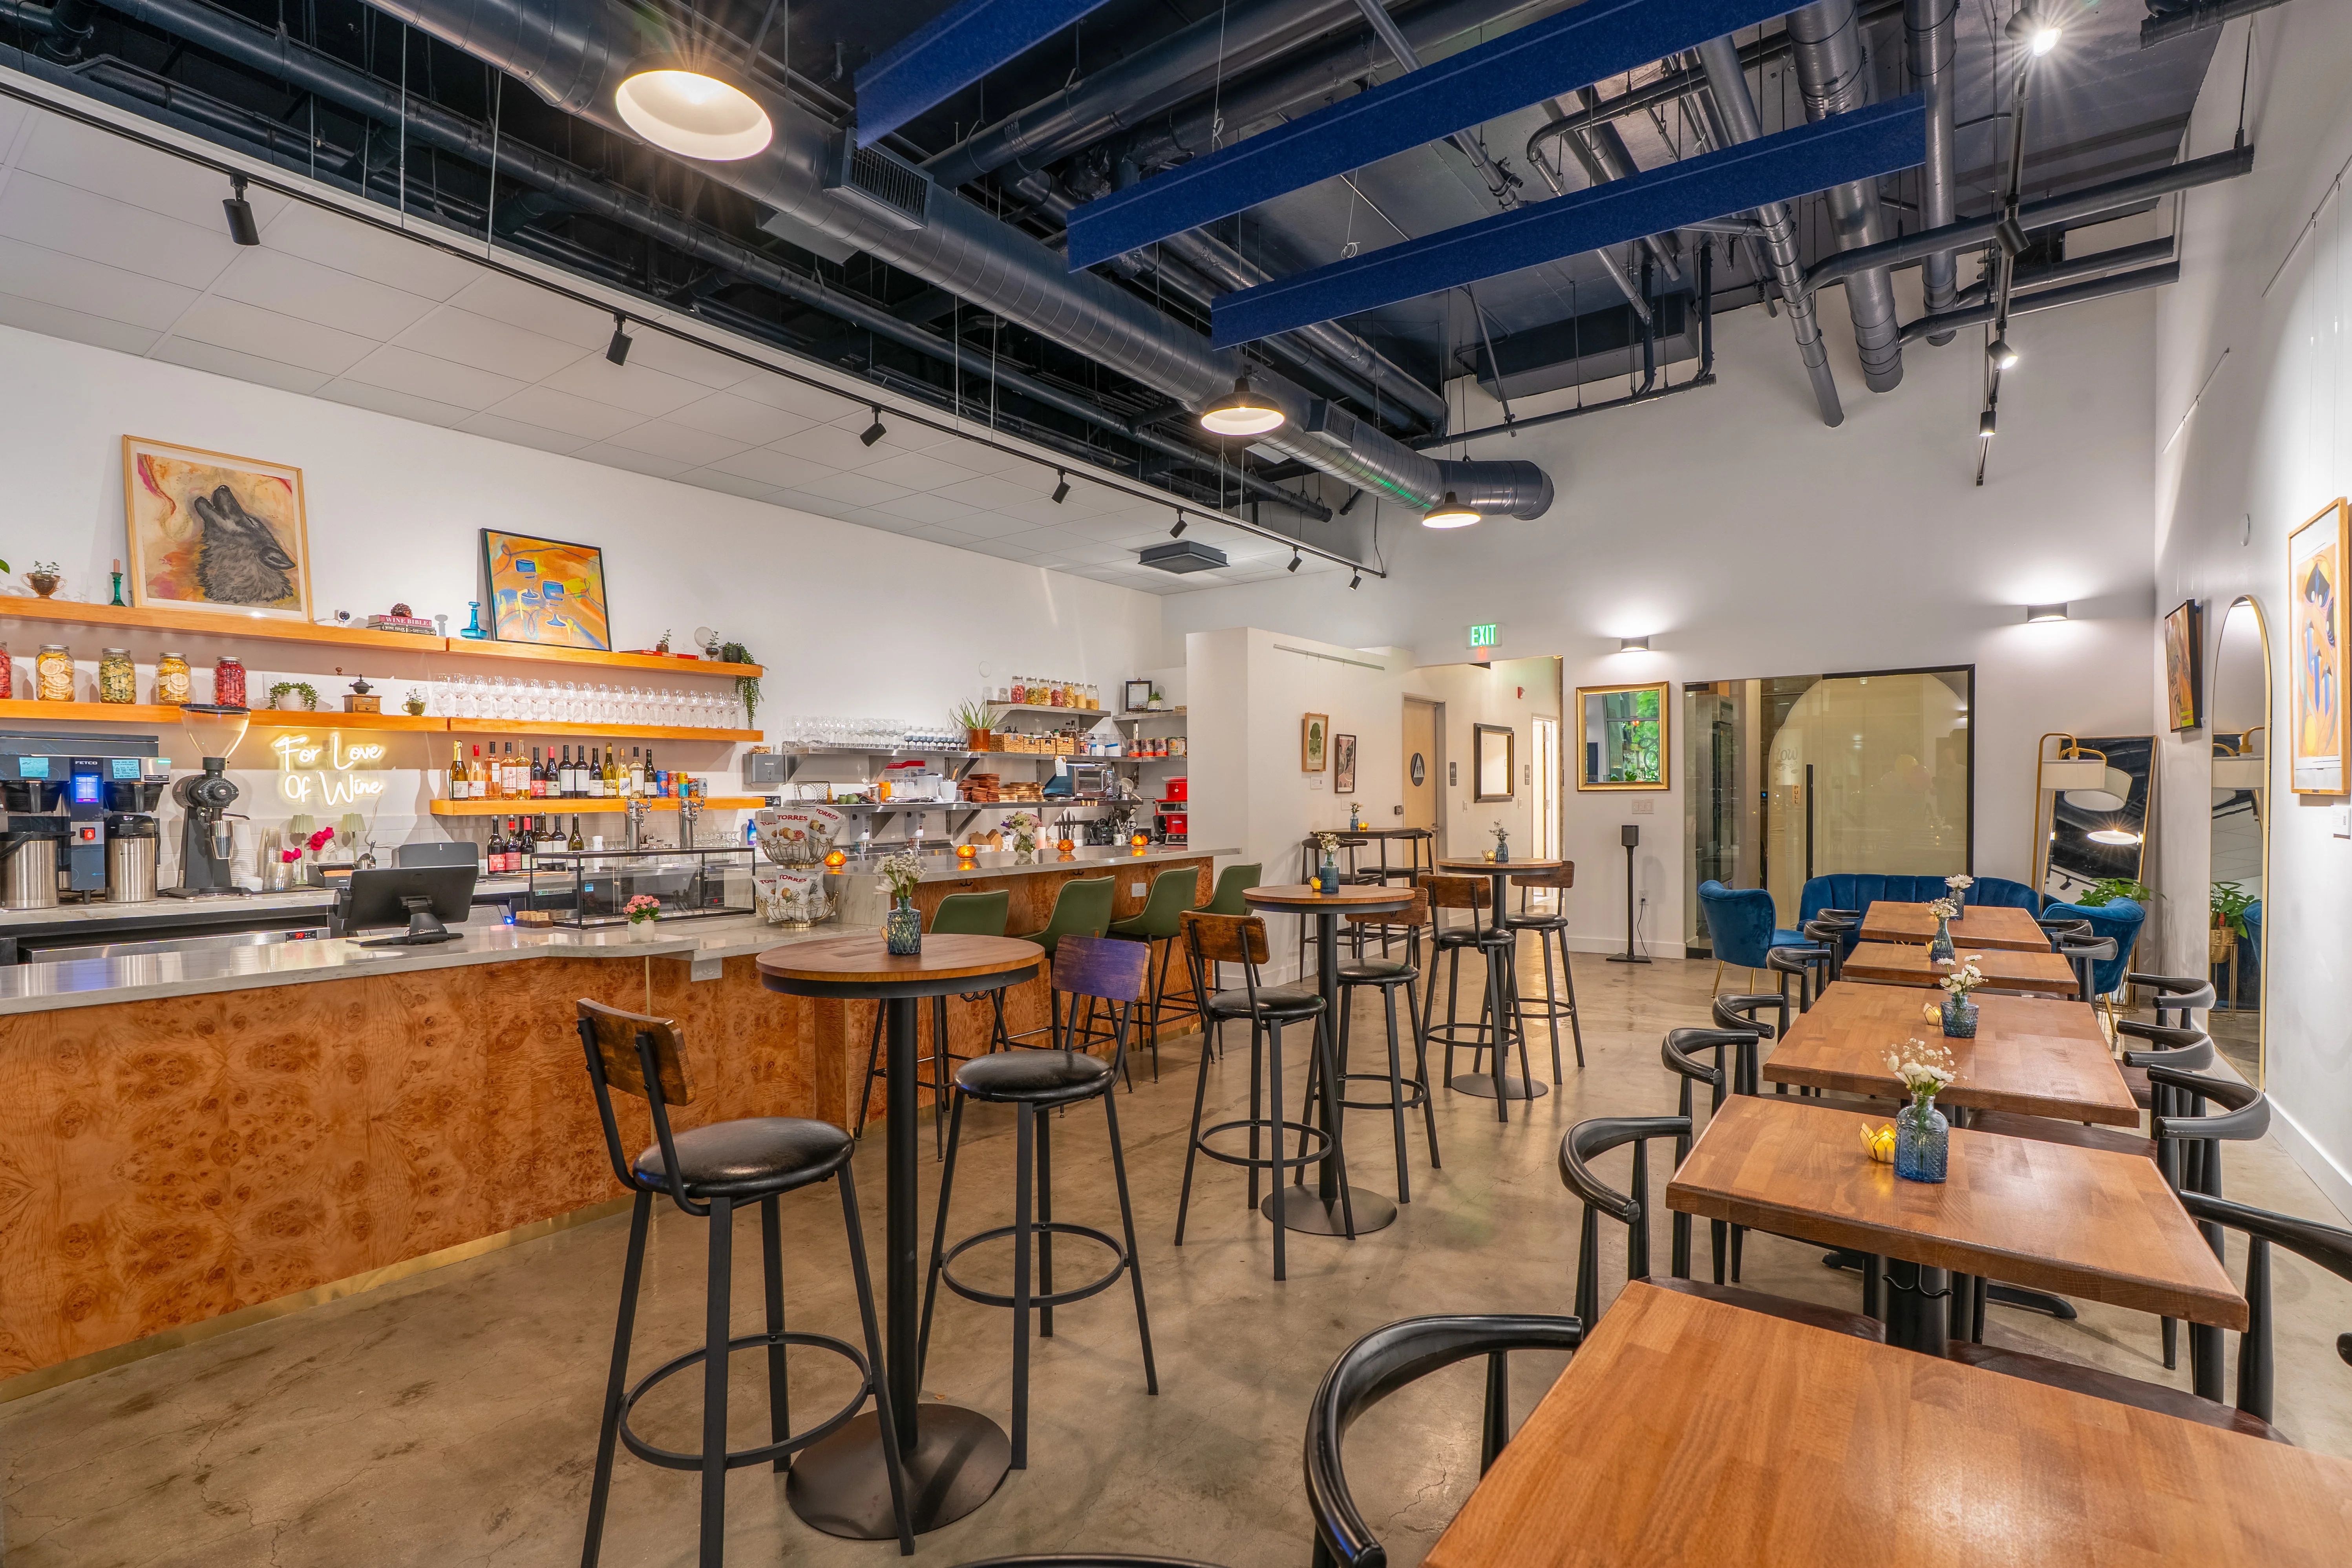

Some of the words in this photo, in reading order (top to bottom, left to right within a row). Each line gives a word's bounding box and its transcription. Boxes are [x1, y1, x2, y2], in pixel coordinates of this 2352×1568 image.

[1471, 624, 1497, 646] EXIT
[274, 736, 321, 773] For
[333, 735, 382, 770] Love
[285, 775, 311, 802] Of
[317, 771, 384, 806] Wine
[816, 808, 839, 820] TORRES
[779, 874, 808, 883] TORRES
